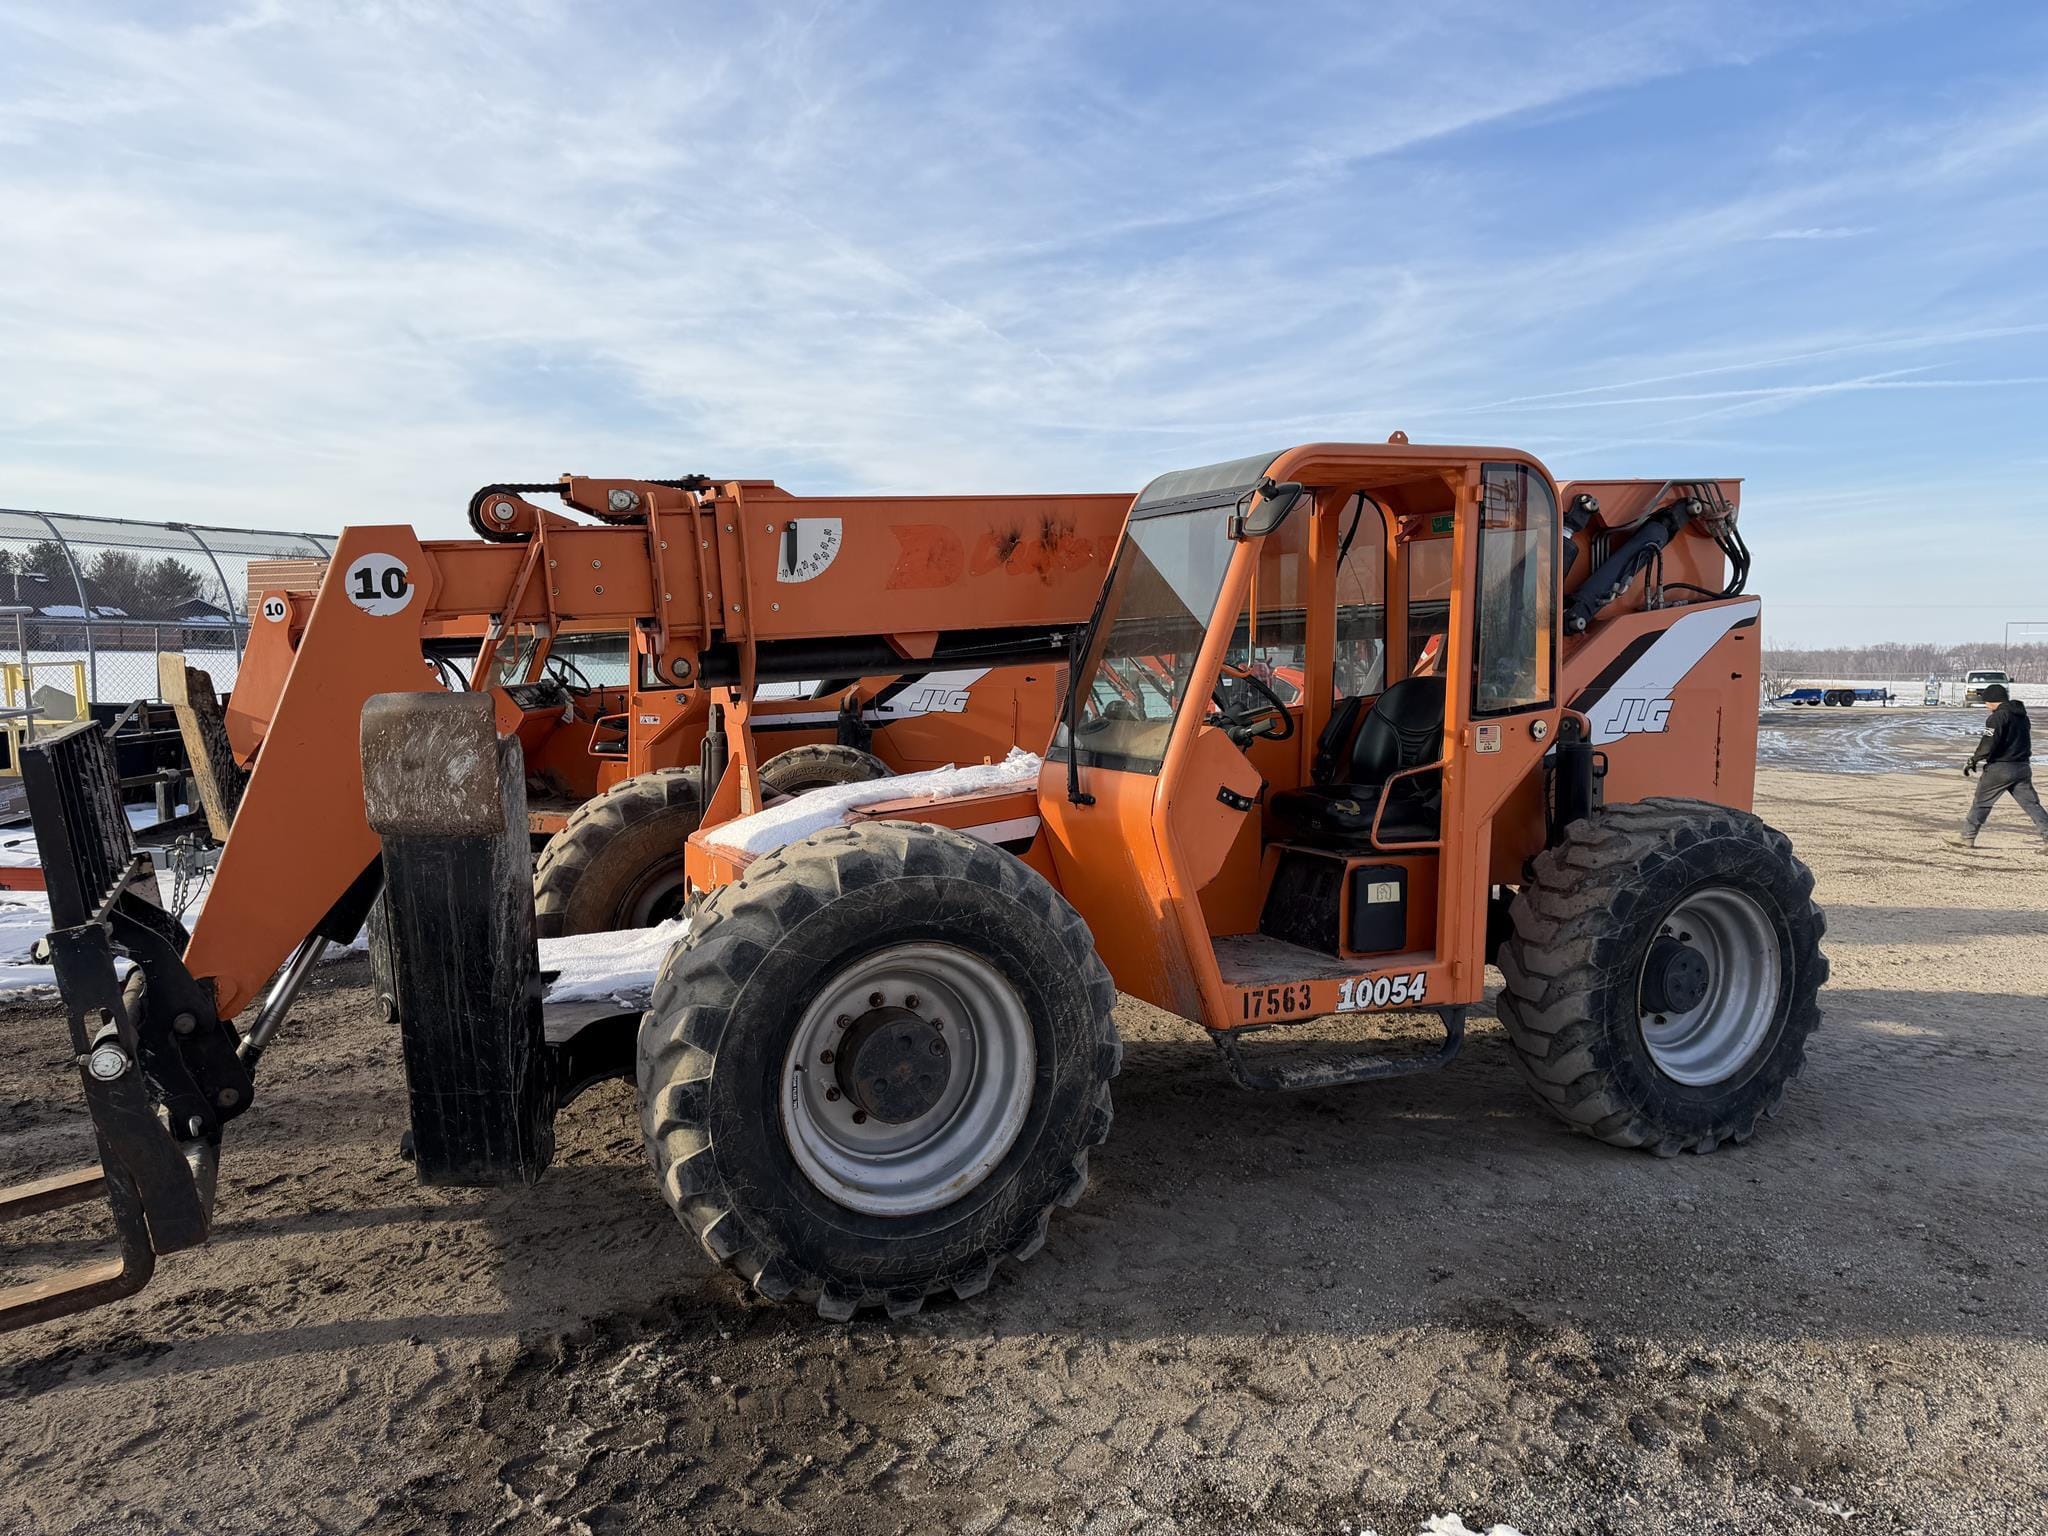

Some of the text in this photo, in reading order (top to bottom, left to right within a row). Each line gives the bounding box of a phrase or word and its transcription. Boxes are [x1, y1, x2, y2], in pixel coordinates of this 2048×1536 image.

[796, 568, 804, 577] 10
[801, 560, 809, 570] 20
[828, 536, 837, 545] 70
[354, 567, 409, 599] 10
[265, 602, 284, 616] 10
[909, 689, 972, 713] JLG
[1605, 698, 1675, 734] JLG
[1243, 971, 1427, 1019] 17563 10054
